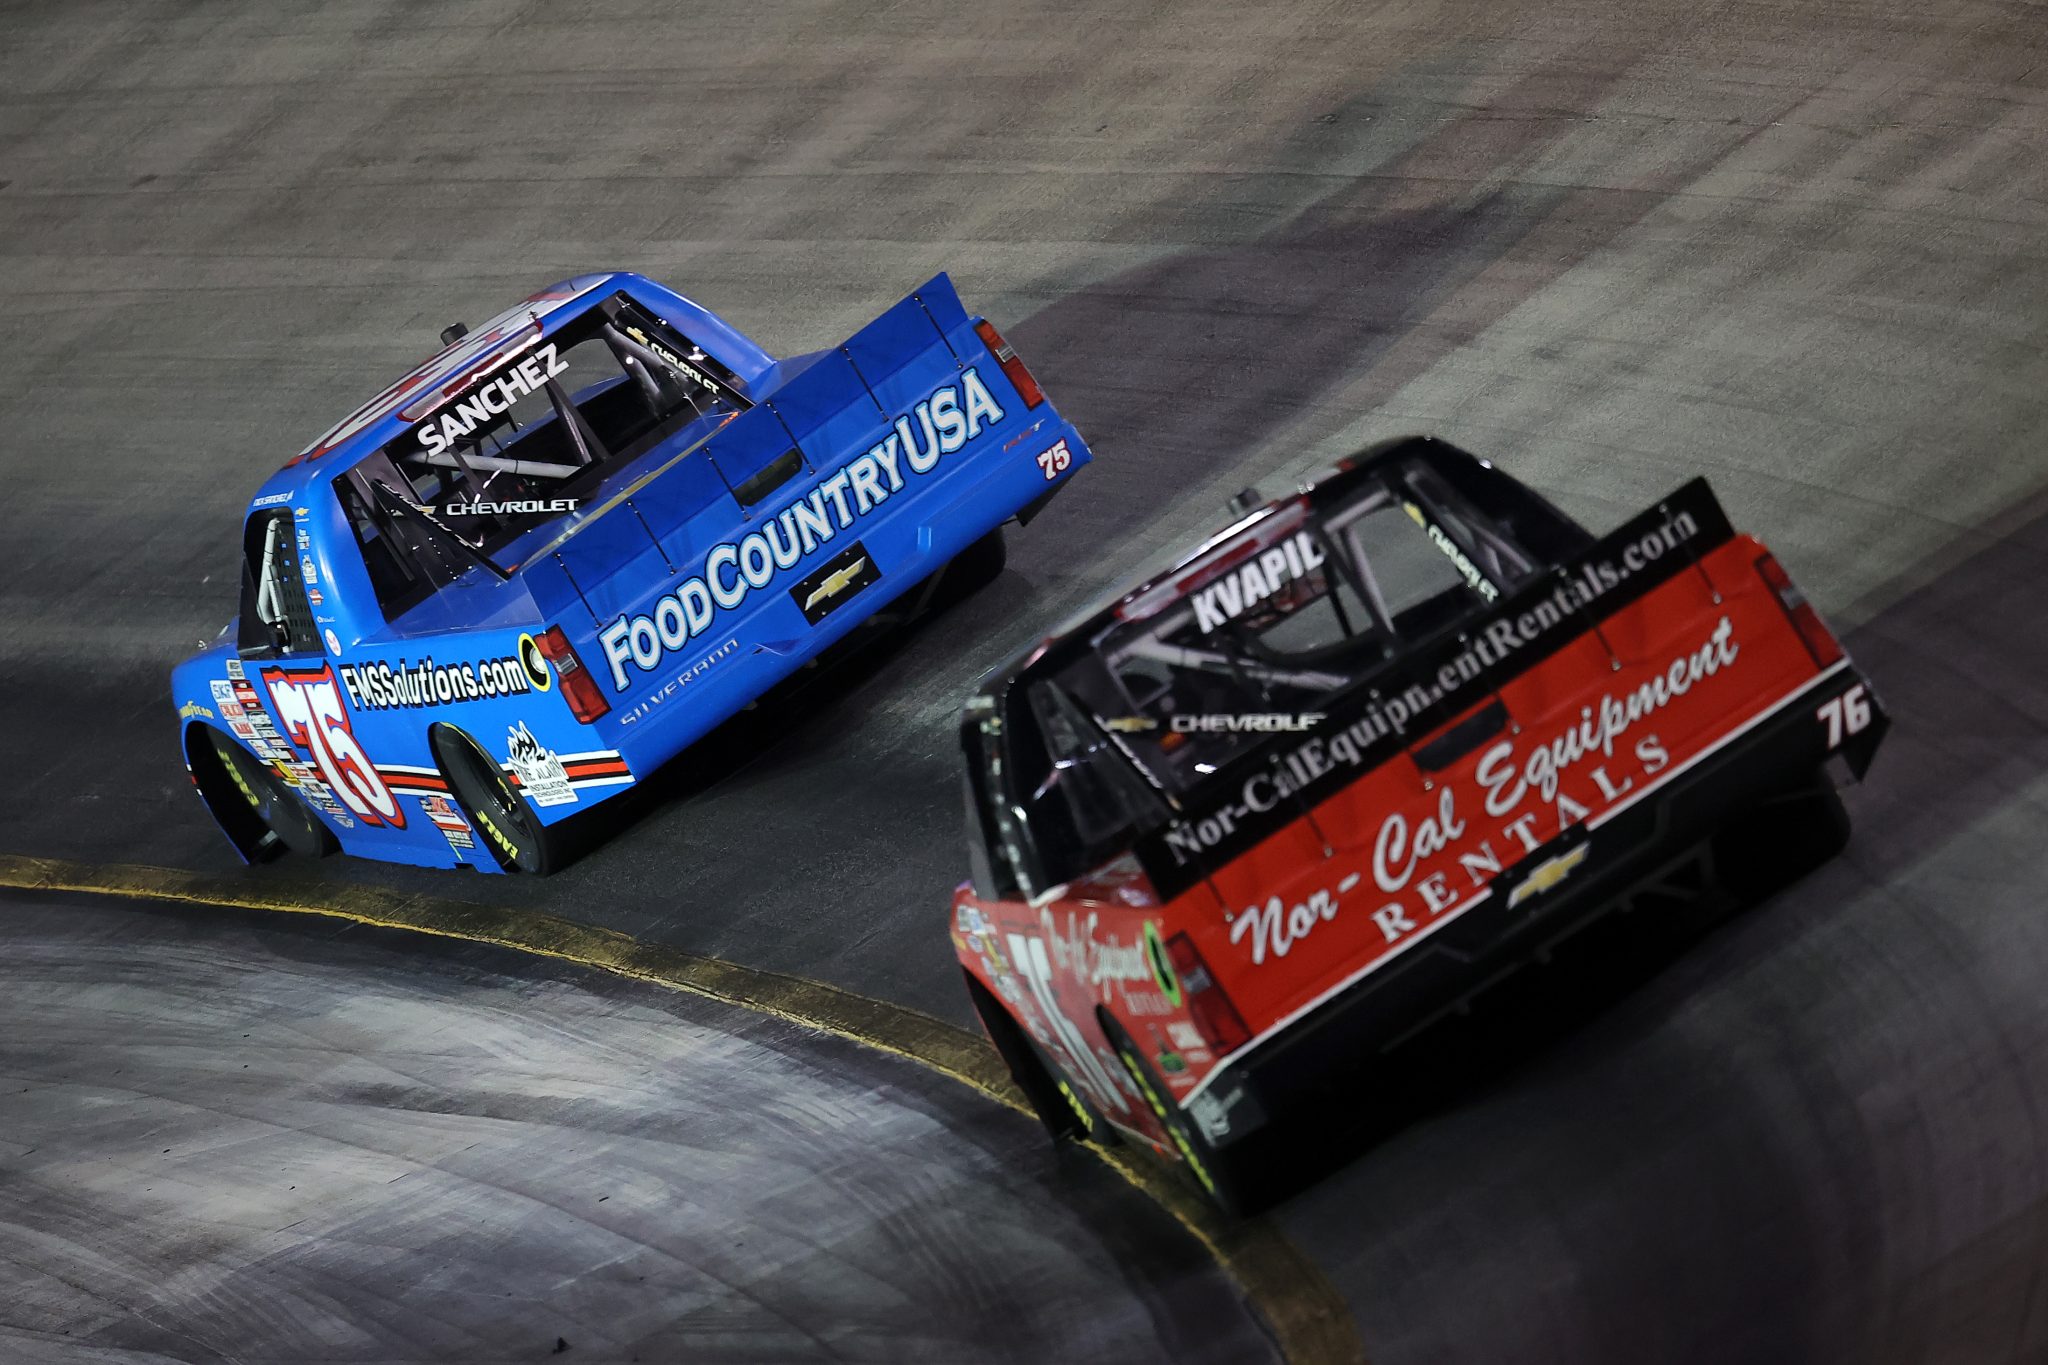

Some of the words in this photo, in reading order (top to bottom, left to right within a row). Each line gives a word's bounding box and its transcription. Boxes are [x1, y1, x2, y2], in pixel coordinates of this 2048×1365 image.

[417, 343, 570, 458] SANCHEZ
[1036, 439, 1072, 480] 75
[446, 498, 579, 517] CHEVROLET
[1191, 531, 1326, 634] KVAPIL
[338, 656, 530, 709] FMSSolutions.com
[1476, 615, 1741, 818] Equipment
[1815, 683, 1872, 751] 76
[262, 664, 402, 823] 75
[476, 810, 519, 860] EAGLE
[1369, 734, 1671, 944] RENTALS
